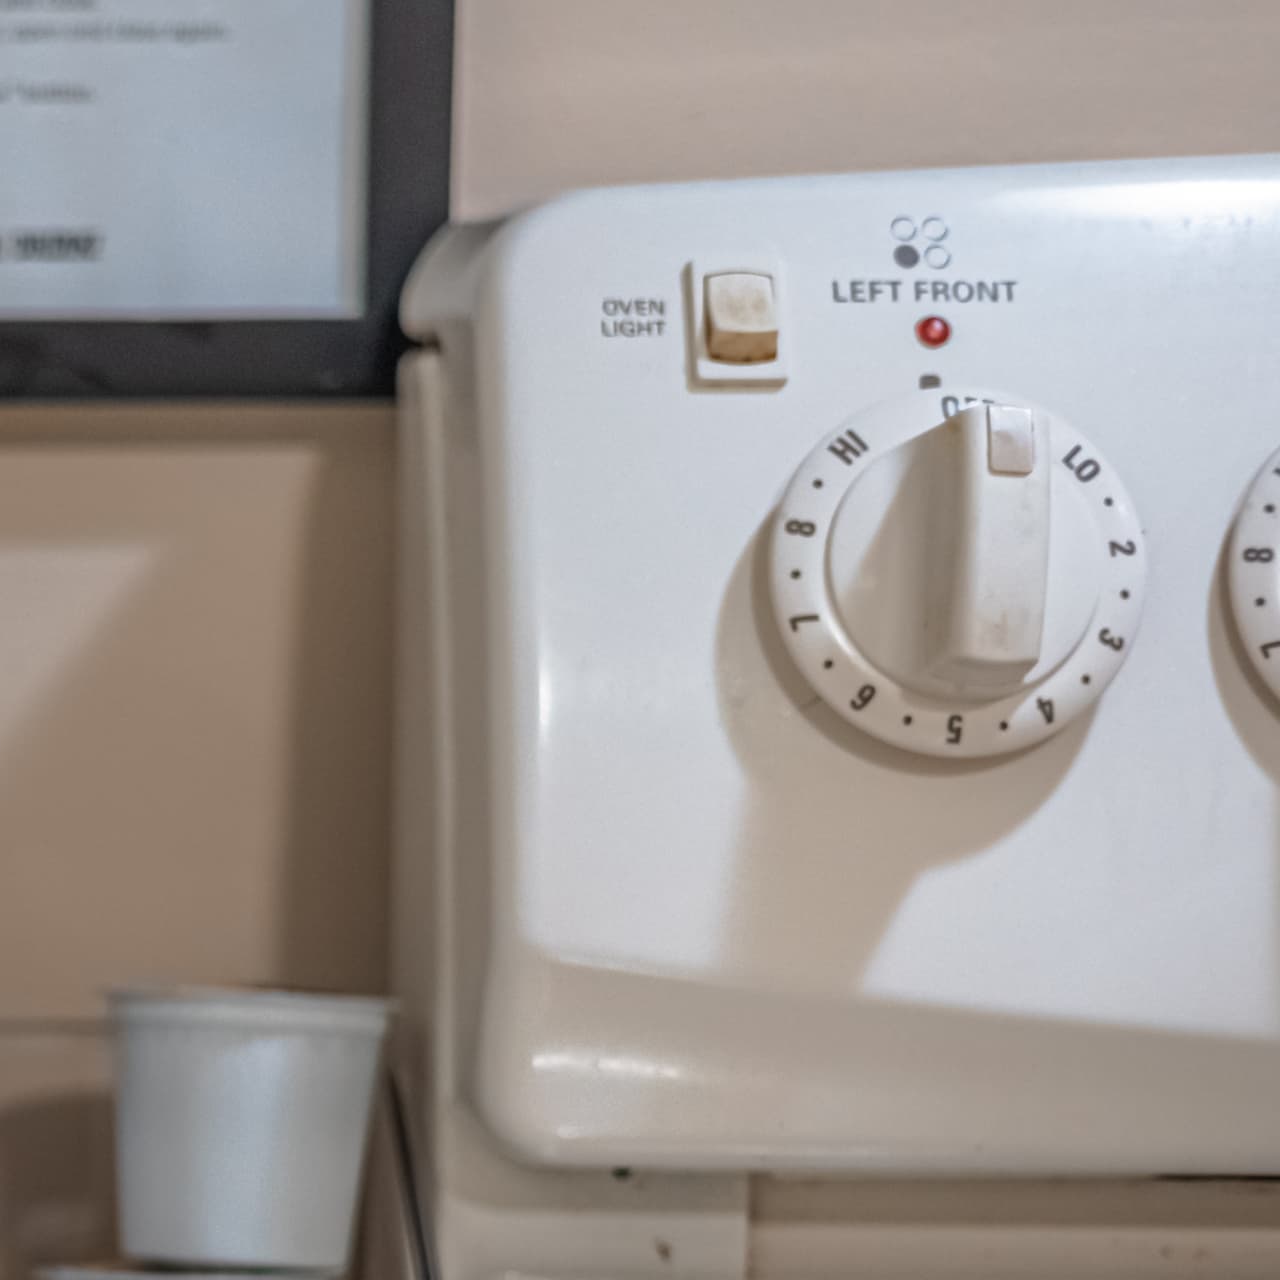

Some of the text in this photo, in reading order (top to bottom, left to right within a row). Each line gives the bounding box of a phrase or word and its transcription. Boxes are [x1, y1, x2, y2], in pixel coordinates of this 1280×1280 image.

[831, 280, 1018, 304] LEFT FRONT
[602, 299, 666, 316] OVEN
[601, 320, 666, 337] LIGHT
[827, 429, 870, 466] HI
[1061, 444, 1102, 484] LO
[784, 518, 816, 538] 8
[1108, 539, 1137, 558] 2
[1242, 547, 1276, 564] 8
[788, 612, 820, 633] 7
[1096, 625, 1126, 652] 3
[1035, 697, 1057, 724] 4
[944, 715, 964, 744] 5
